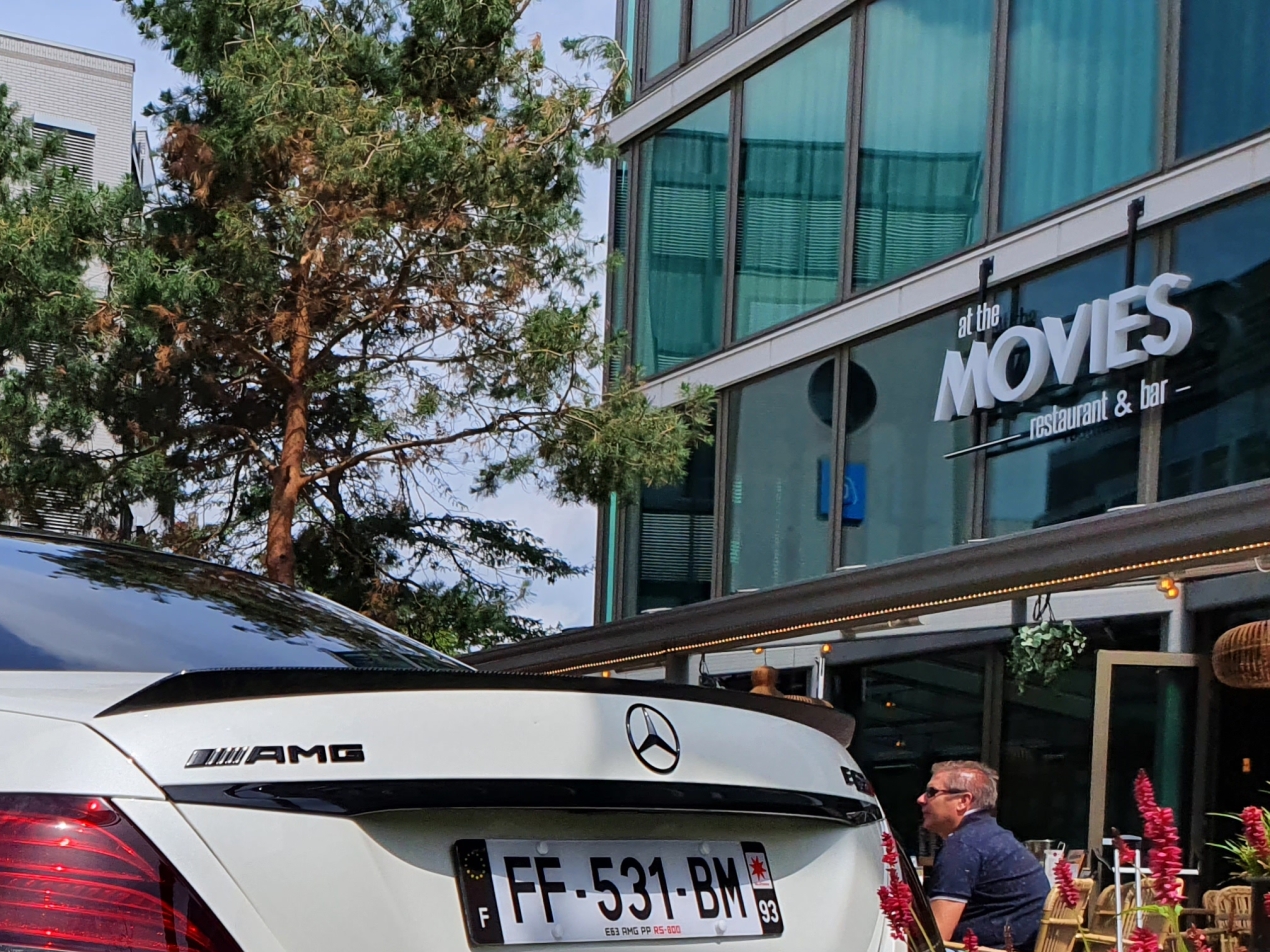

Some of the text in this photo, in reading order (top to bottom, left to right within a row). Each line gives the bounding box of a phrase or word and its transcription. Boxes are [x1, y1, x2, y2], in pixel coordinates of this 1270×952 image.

[958, 302, 1000, 339] at the
[934, 272, 1192, 422] MOVIES
[1029, 379, 1169, 441] restaurant & bar
[244, 743, 365, 765] AMG
[503, 856, 748, 923] FF-531-BM
[478, 906, 490, 929] F
[758, 899, 780, 923] 93
[604, 927, 620, 937] E63
[621, 926, 639, 936] AMG
[640, 926, 652, 935] PP
